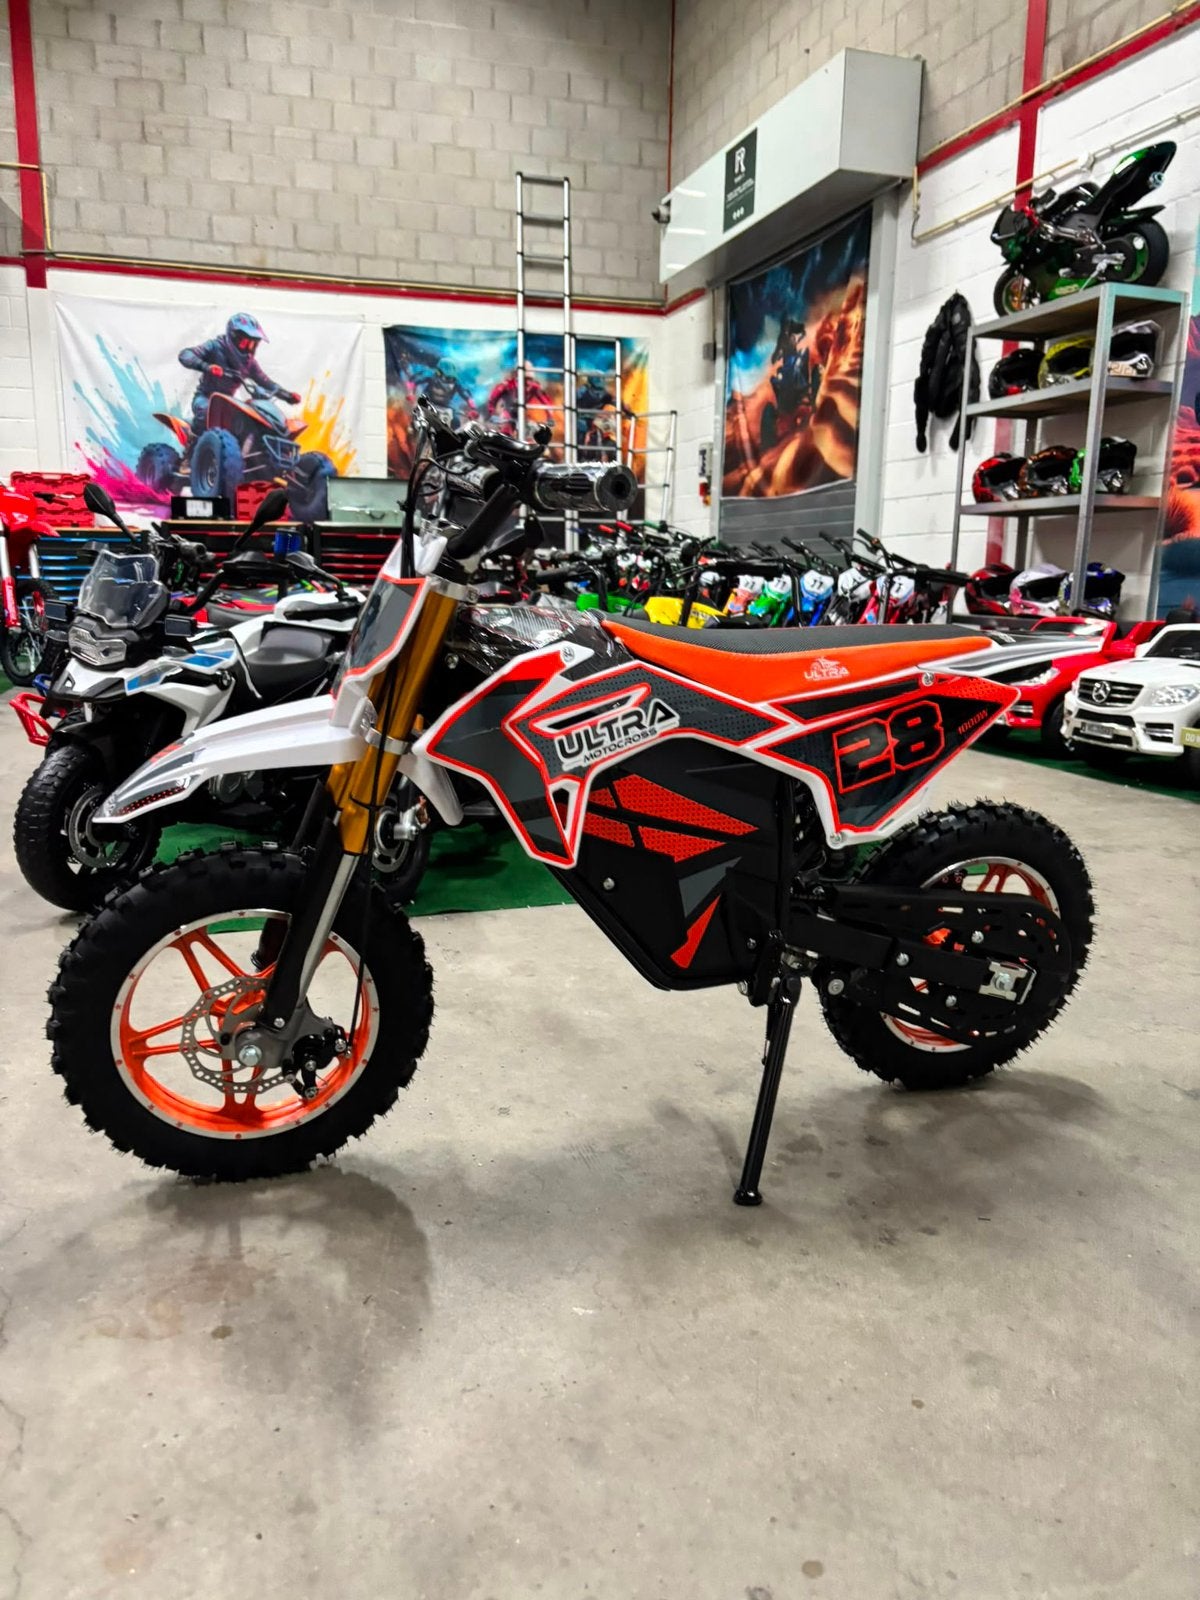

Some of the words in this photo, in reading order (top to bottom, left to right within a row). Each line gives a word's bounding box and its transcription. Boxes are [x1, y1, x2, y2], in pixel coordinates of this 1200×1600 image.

[803, 666, 850, 682] ULTRA
[556, 700, 678, 760] ULTRA
[583, 728, 658, 763] MOTOCROSS
[833, 700, 945, 794] 28
